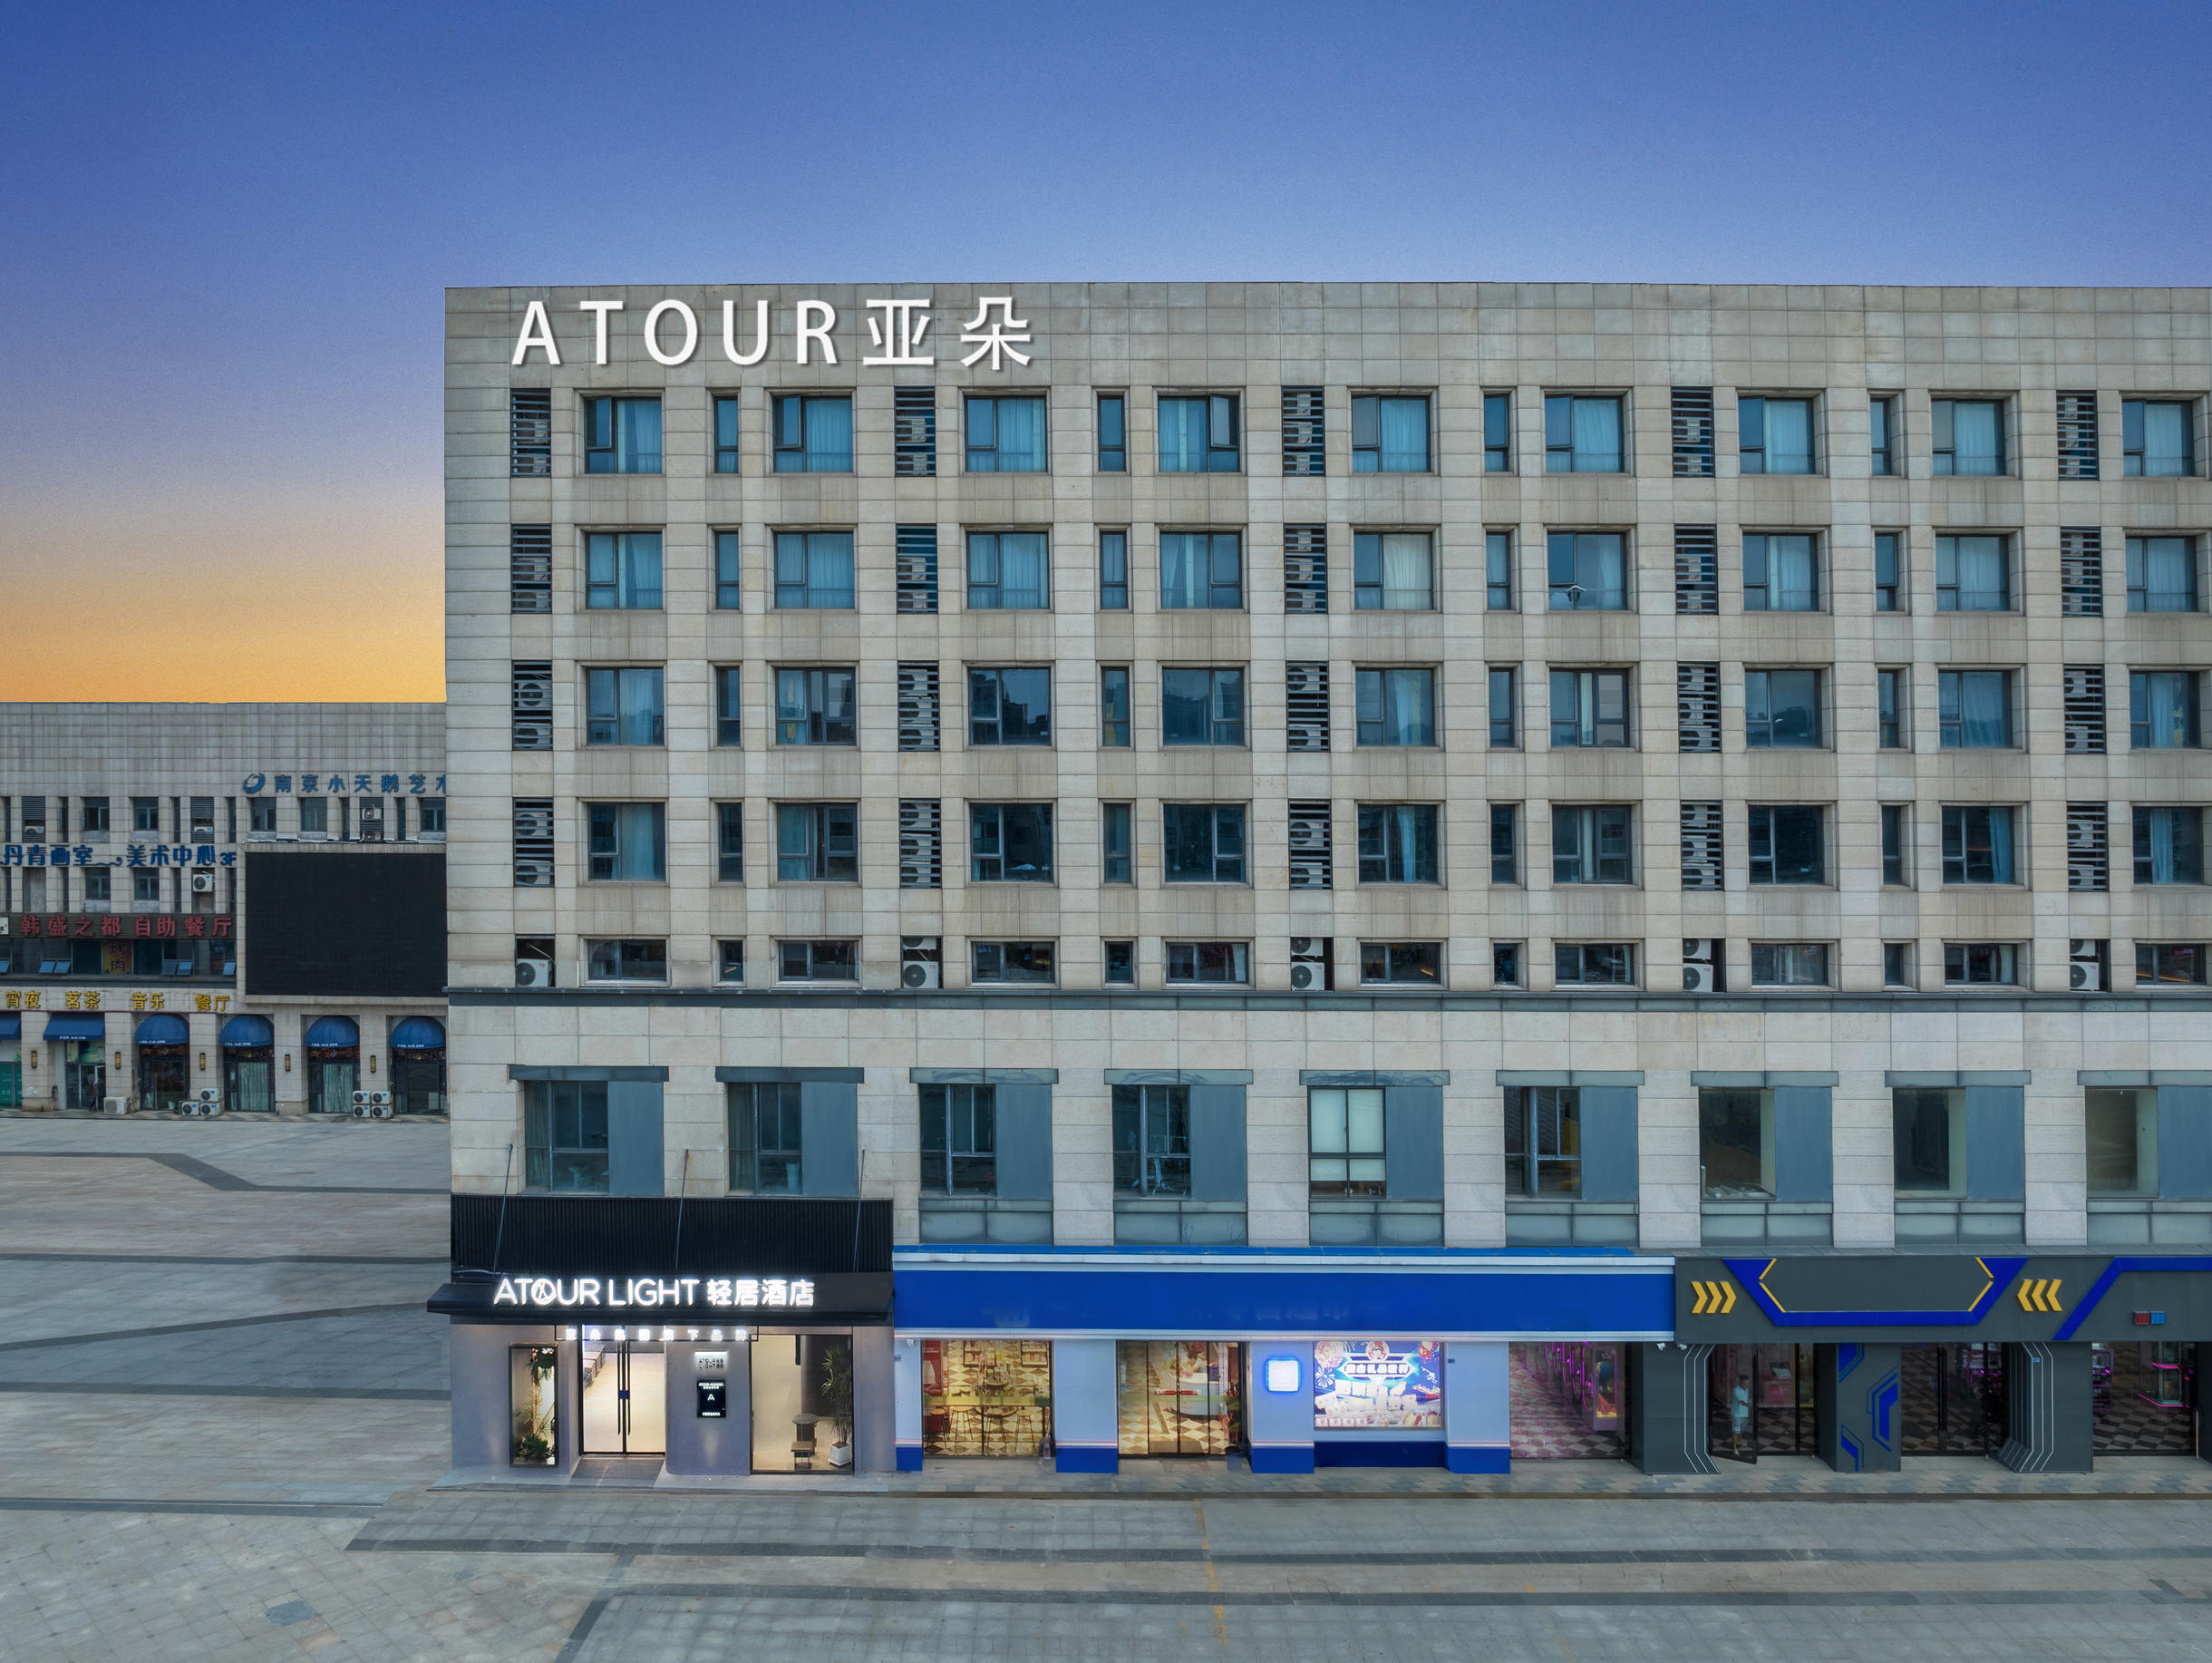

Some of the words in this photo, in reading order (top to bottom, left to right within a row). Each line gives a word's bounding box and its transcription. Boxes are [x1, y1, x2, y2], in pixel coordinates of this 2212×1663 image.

[511, 299, 839, 366] ATOUR
[862, 297, 1032, 370] 亚朵
[0, 843, 93, 867] 丹青画室
[127, 844, 217, 867] 美术中心
[21, 915, 121, 937] 韩盛之都
[135, 915, 232, 937] 自助餐厅
[5, 990, 41, 1009] 宵夜
[65, 991, 100, 1009] 茗茶
[131, 991, 165, 1010] 音乐
[195, 994, 229, 1012] 餐厅
[493, 1278, 601, 1307] ATOUR
[607, 1278, 701, 1307] LIGHT
[706, 1279, 815, 1307] 轻居酒店
